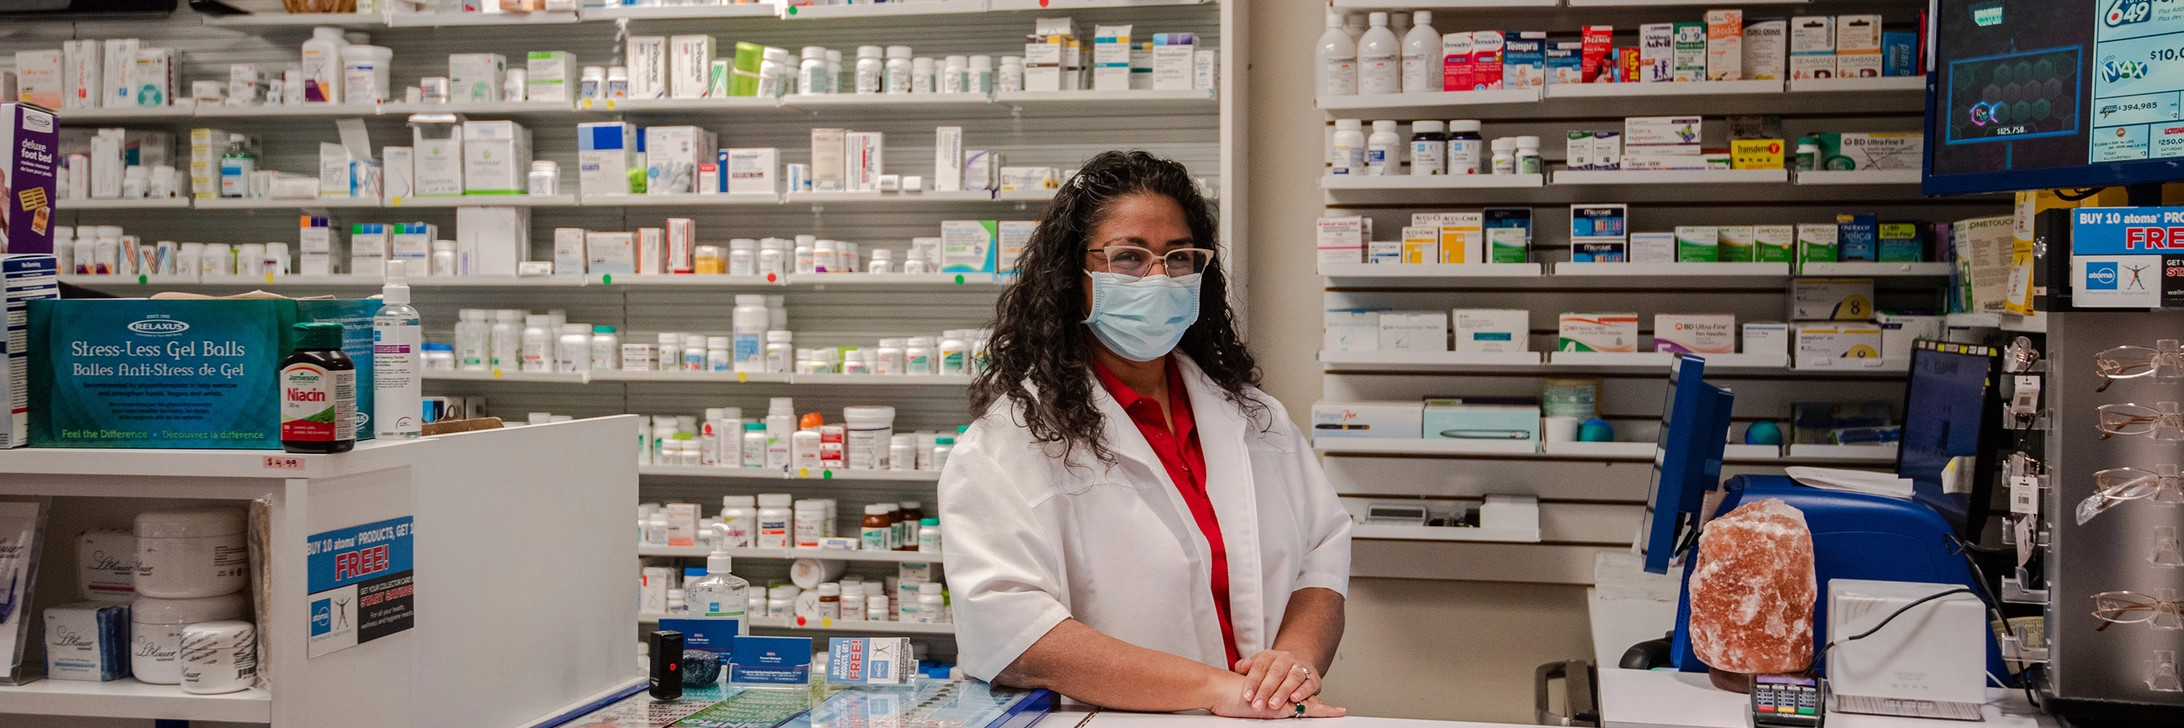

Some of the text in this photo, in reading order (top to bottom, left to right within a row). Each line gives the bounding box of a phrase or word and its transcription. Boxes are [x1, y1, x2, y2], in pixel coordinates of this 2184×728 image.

[1506, 41, 1538, 51] Tempra
[1645, 40, 1671, 48] Advil
[2102, 60, 2148, 83] MAX
[22, 139, 47, 152] deluxe
[21, 148, 52, 163] foot bed
[2080, 213, 2102, 224] BUY
[2106, 213, 2120, 224] 10
[2126, 227, 2184, 249] FRE
[1851, 300, 1860, 315] 8
[72, 341, 245, 360] Stress-Less Gel Balls
[73, 363, 244, 378] Balles Anti-Stress de Gel
[287, 388, 326, 402] Niacin
[62, 430, 81, 439] Feel
[83, 429, 98, 439] the
[100, 429, 148, 439] Difference
[276, 459, 297, 468] 4.99
[308, 541, 321, 555] BUY
[323, 539, 332, 552] 10
[359, 526, 395, 545] PRODUCTS,
[396, 524, 409, 536] GET
[335, 544, 389, 581] FREE!
[360, 594, 385, 608] START
[841, 654, 849, 679] PRODUCTS,
[850, 639, 862, 680] FREE!
